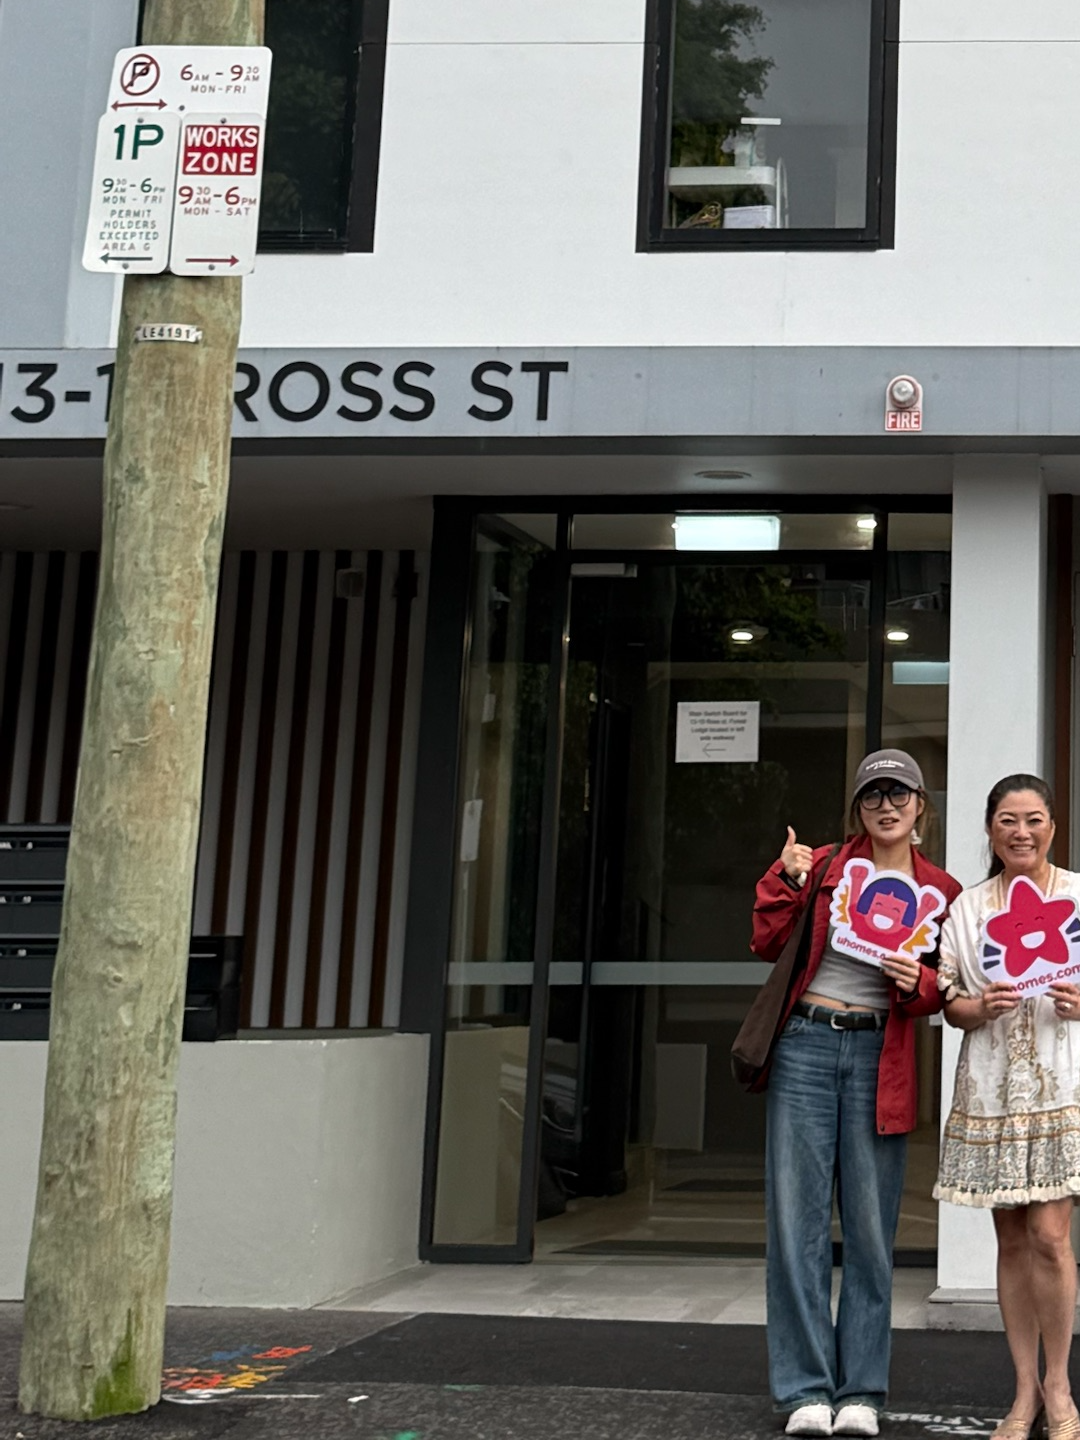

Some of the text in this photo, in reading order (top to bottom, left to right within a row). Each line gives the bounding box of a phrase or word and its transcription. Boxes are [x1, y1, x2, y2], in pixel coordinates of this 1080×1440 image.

[114, 124, 164, 160] 1P
[187, 127, 258, 148] WORKS
[185, 152, 254, 172] ZONE
[110, 209, 151, 218] PERMIT
[104, 220, 156, 229] HOLDERS
[99, 231, 159, 240] EXCEPTED
[102, 242, 136, 251] AREA
[142, 326, 191, 339] LE4191
[468, 361, 569, 422] ST
[887, 411, 920, 429] FIRE
